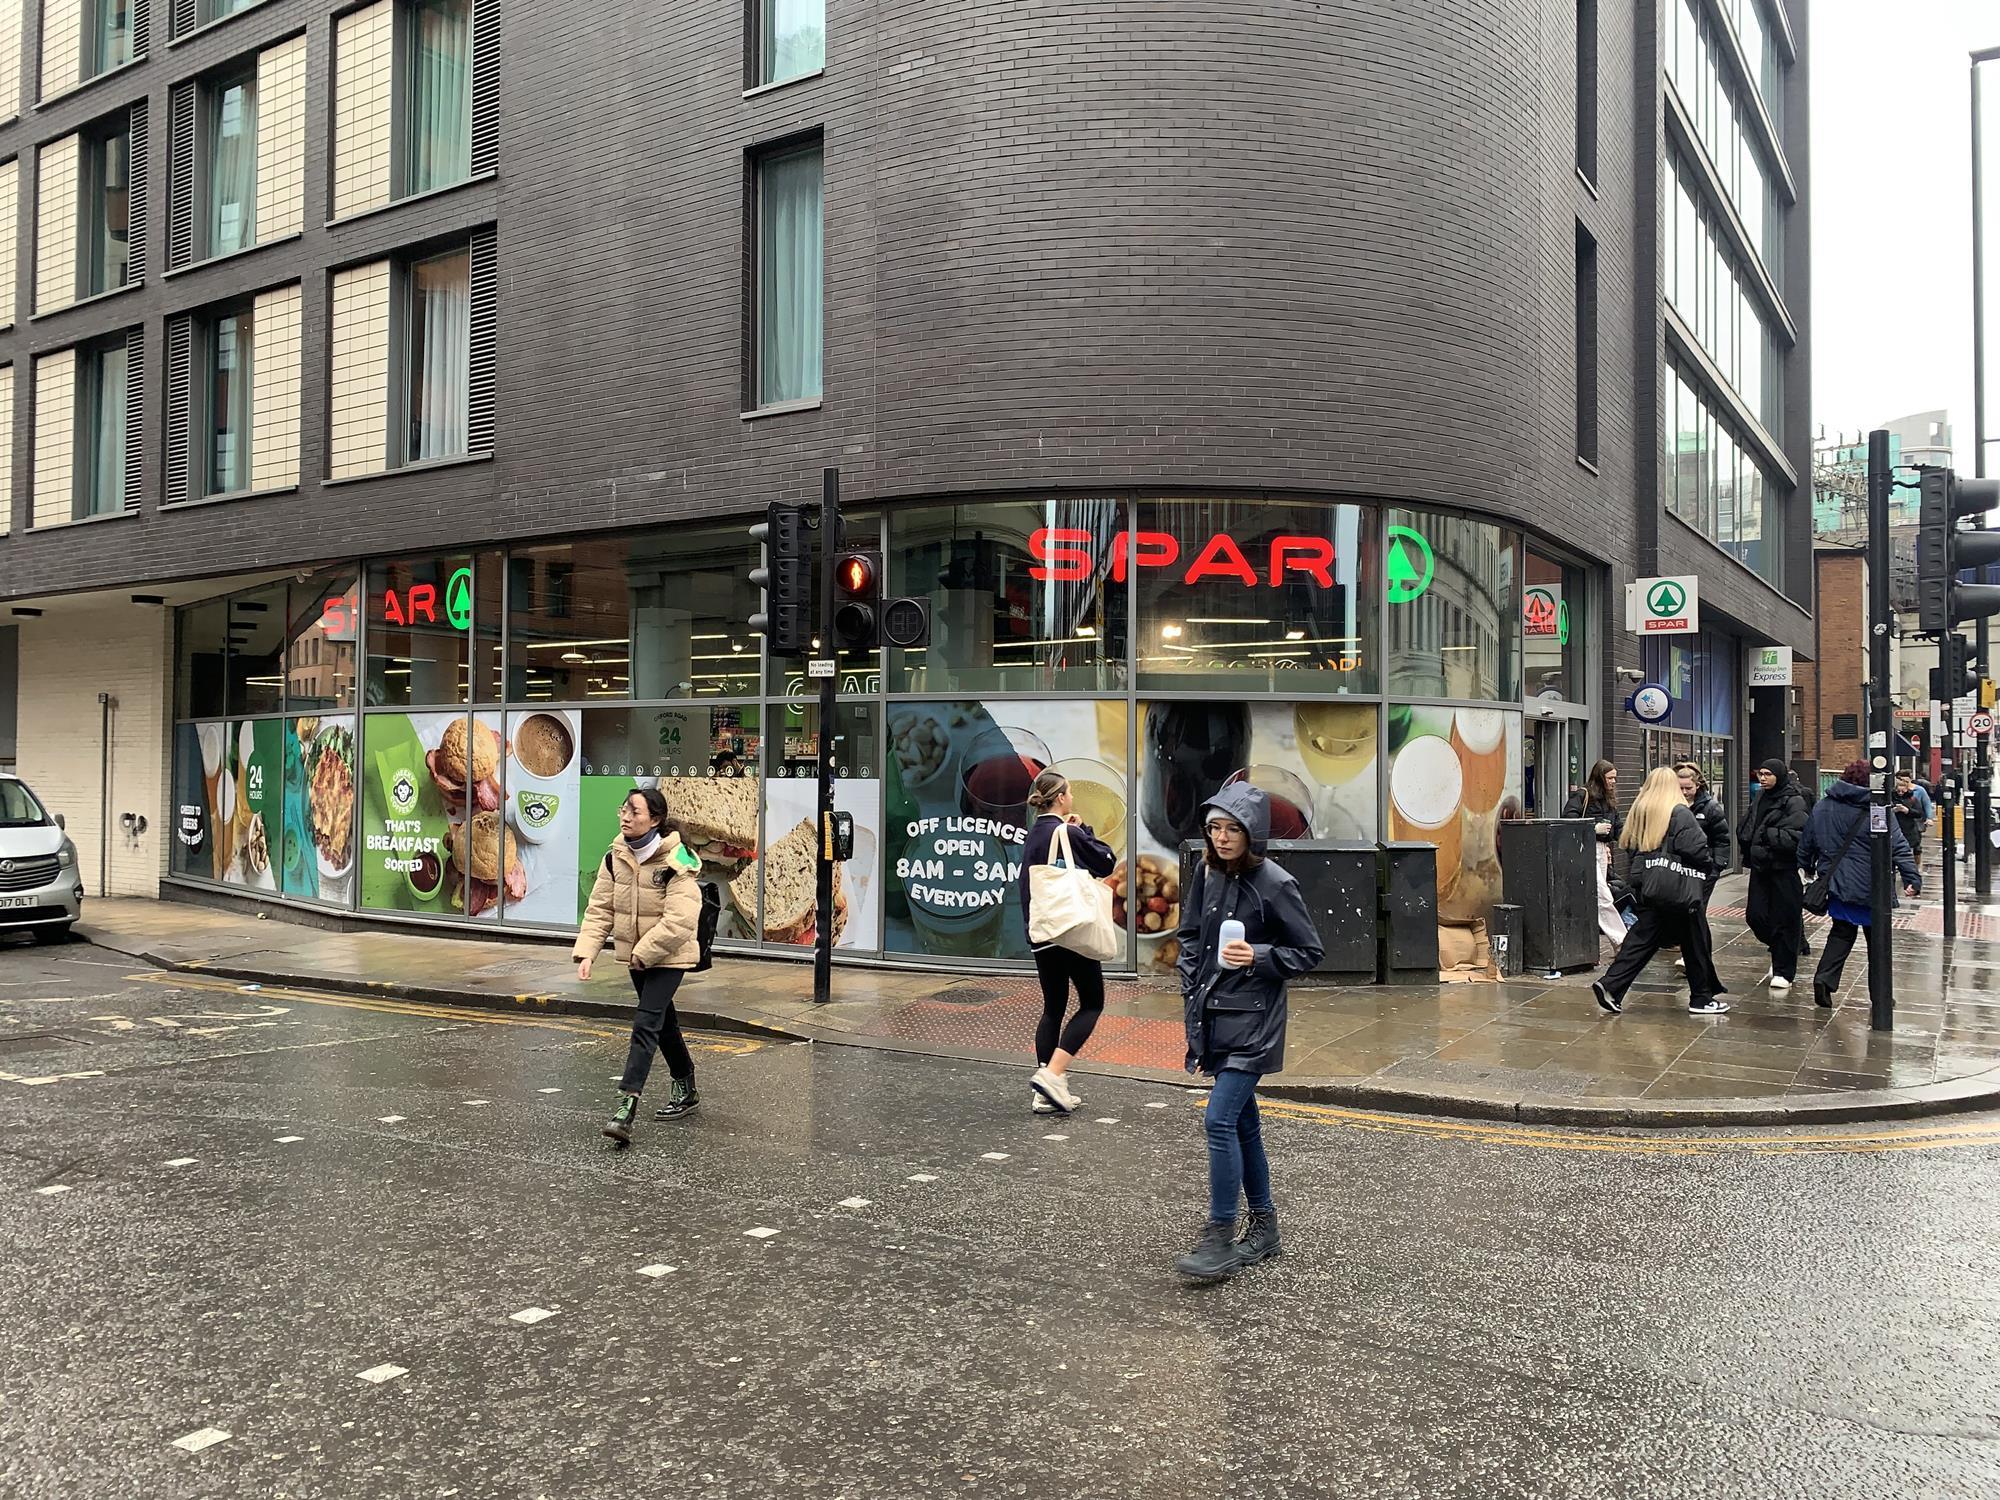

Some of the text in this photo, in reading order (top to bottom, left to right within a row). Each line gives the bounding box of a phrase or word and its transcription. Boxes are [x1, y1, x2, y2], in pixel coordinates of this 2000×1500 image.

[1028, 528, 1335, 589] SPAR
[323, 583, 436, 635] SAR
[1647, 620, 1687, 629] SPAR
[1753, 673, 1787, 682] Express
[674, 711, 688, 722] ROAD
[1973, 718, 1991, 728] 20
[659, 726, 681, 745] 24
[659, 747, 681, 755] HOURS
[249, 765, 263, 788] 24
[393, 769, 416, 782] CHEEKY
[249, 791, 263, 799] HOURS
[522, 793, 558, 806] CHEEKY
[390, 795, 409, 814] COFFEE
[384, 819, 421, 833] THAT'S
[906, 816, 1029, 845] OFF LICENCE
[366, 835, 440, 853] BREAKFAST
[934, 839, 984, 856] OPEN
[384, 858, 423, 872] SORTED
[896, 857, 1023, 882] 8AM - 3AM
[911, 883, 1005, 907] EVERYDAY
